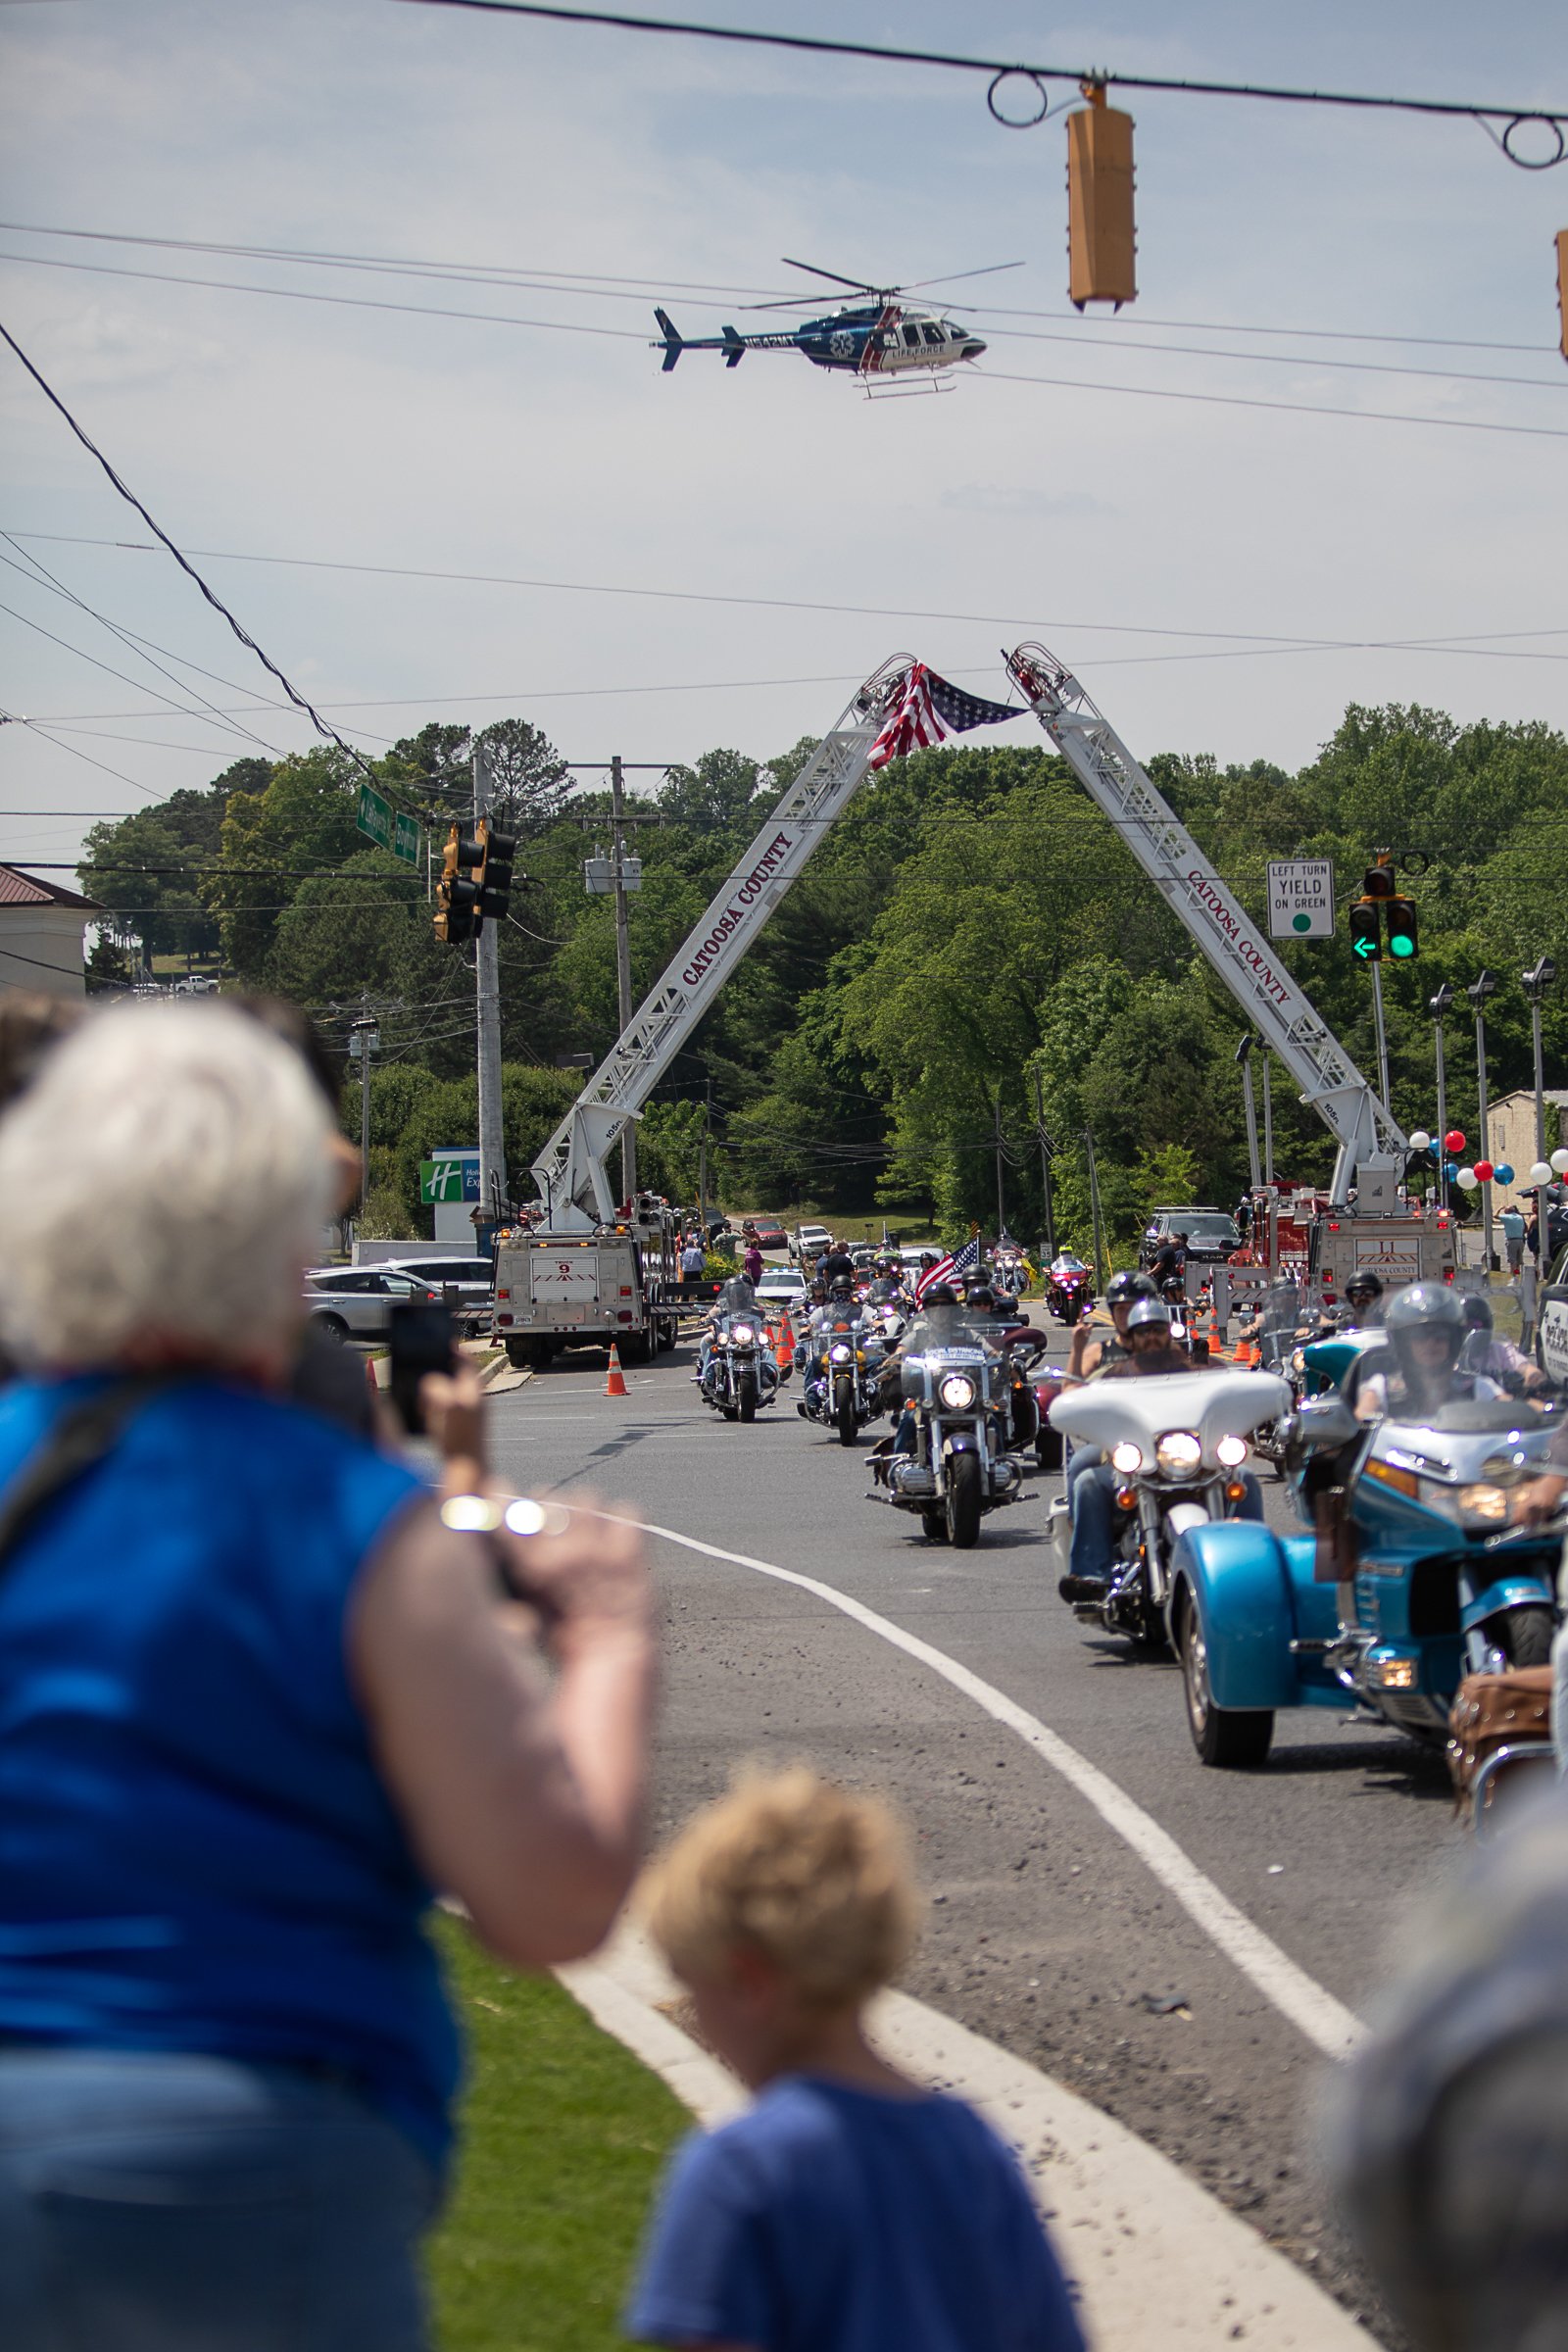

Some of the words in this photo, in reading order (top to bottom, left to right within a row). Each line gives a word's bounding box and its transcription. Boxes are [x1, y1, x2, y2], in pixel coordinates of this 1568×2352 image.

[892, 350, 912, 359] LIFE
[914, 345, 945, 357] FORCE
[1272, 866, 1295, 877] LEFT
[1301, 864, 1327, 876] TURN
[1279, 879, 1322, 895] YIELD
[682, 907, 745, 985] CATOOSA
[738, 831, 793, 906] COUNTY
[1275, 899, 1289, 909] ON
[1295, 898, 1326, 908] GREEN
[1188, 870, 1241, 941] CATOOSA
[1238, 940, 1292, 1005] COUNTY
[559, 1264, 570, 1273] 9
